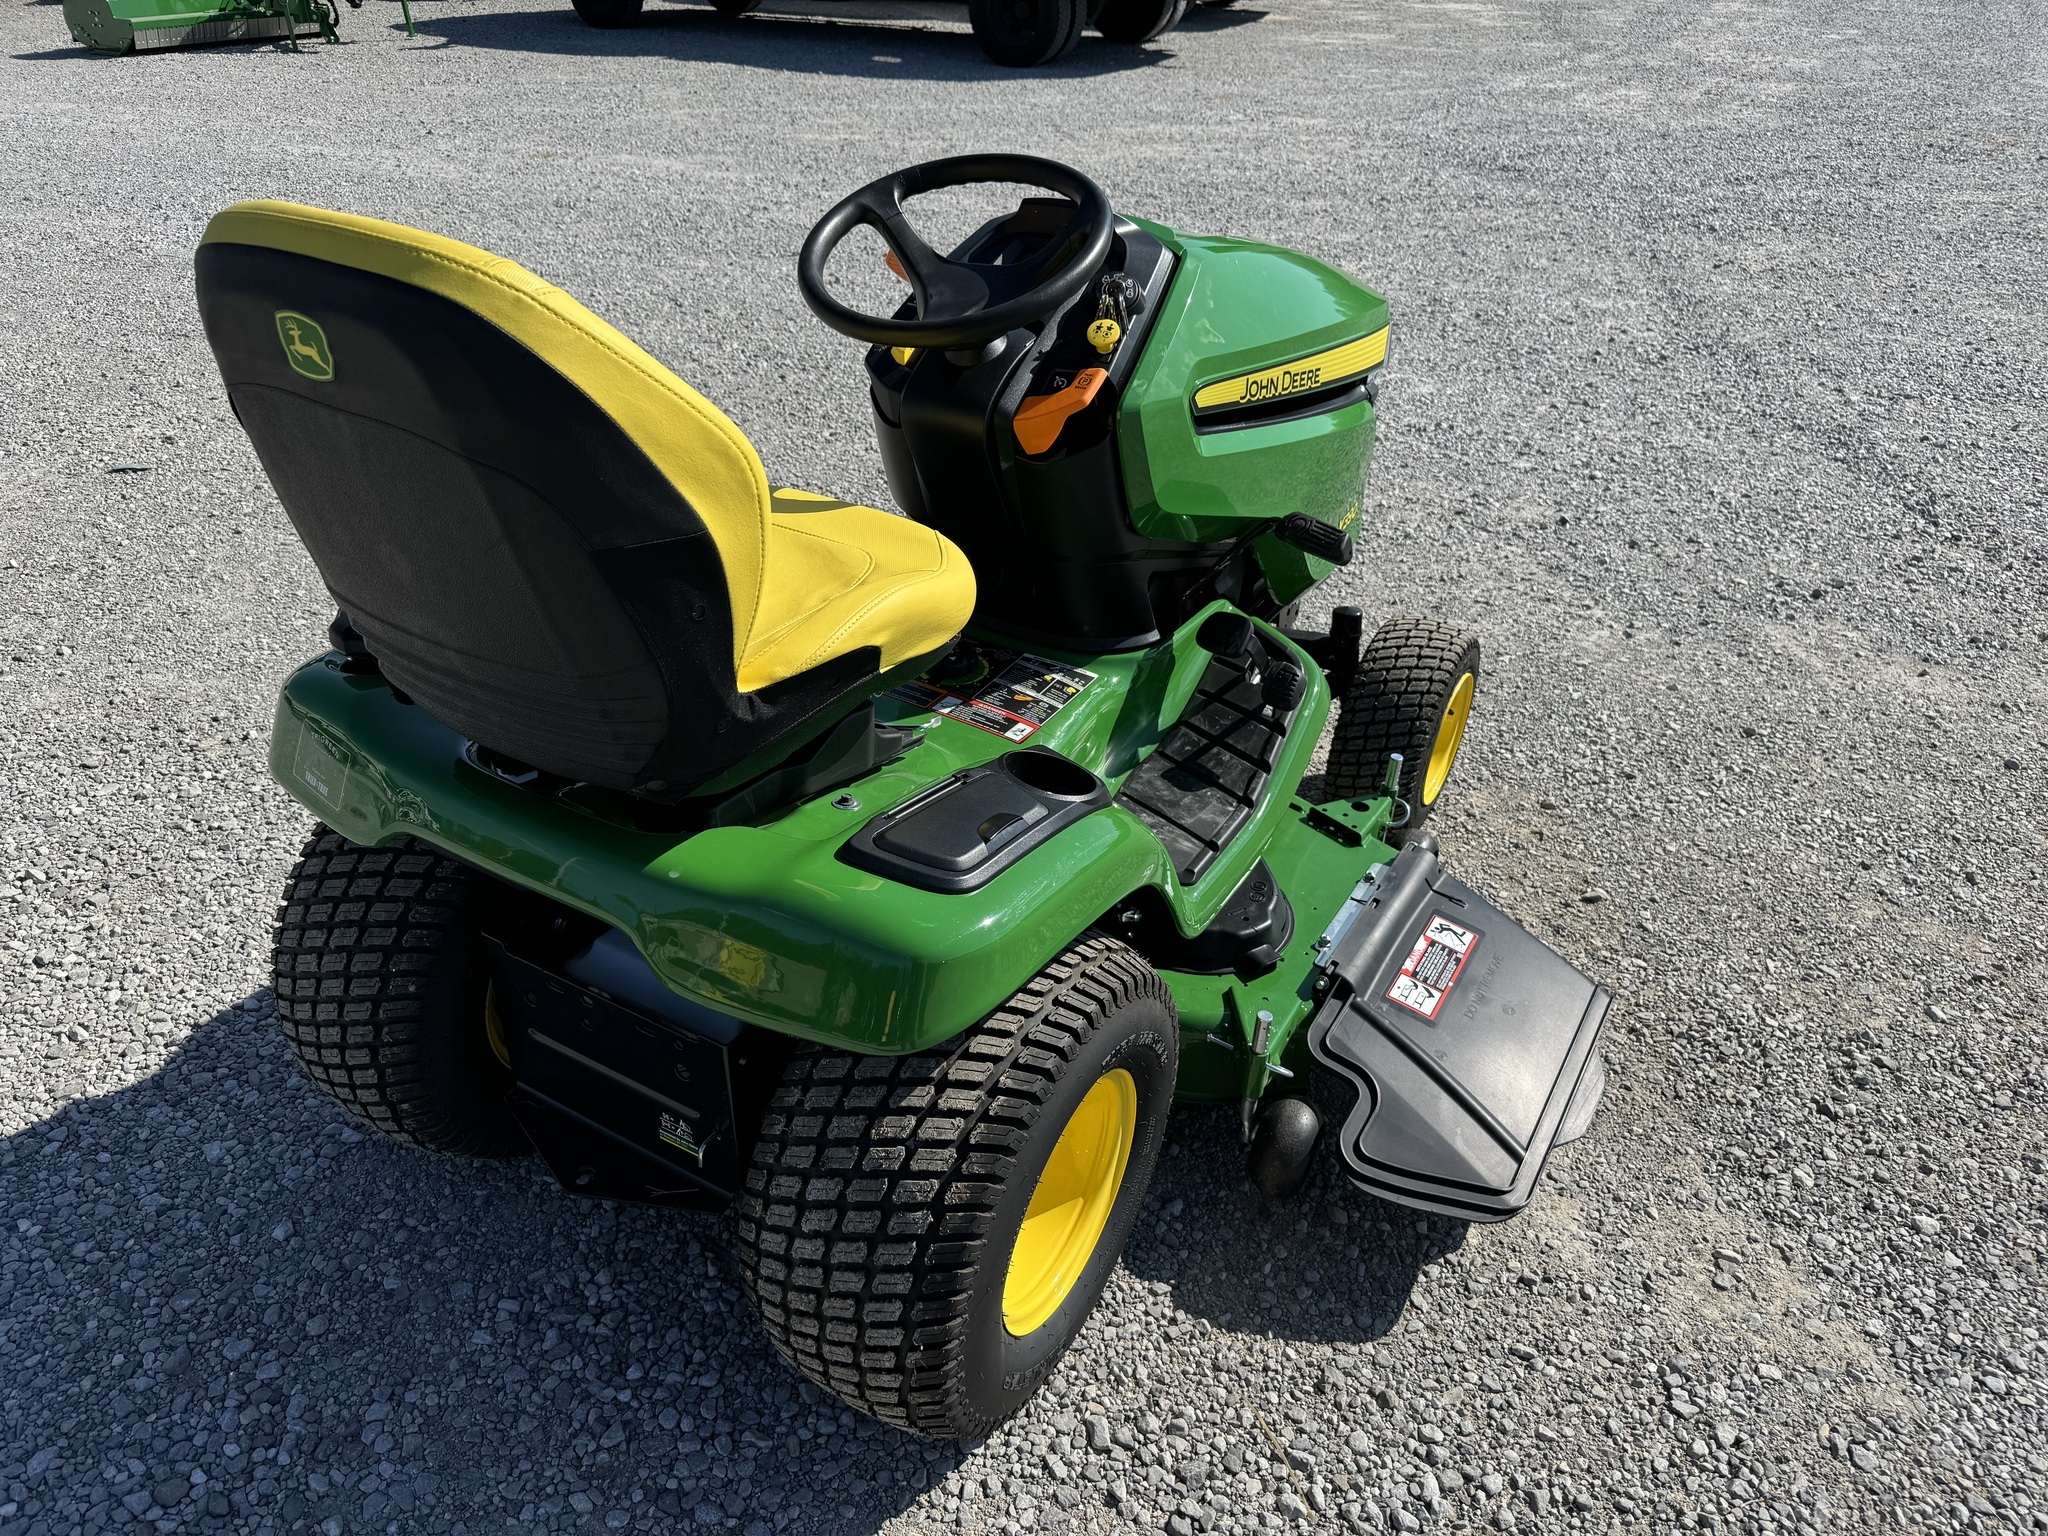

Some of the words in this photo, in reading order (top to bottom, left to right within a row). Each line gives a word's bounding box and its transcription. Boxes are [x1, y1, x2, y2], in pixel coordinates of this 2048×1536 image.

[1239, 377, 1280, 401] JOHN
[1281, 367, 1322, 392] DEERE
[1479, 952, 1505, 989] REMOVE
[1471, 986, 1488, 1006] NOT
[1463, 1004, 1478, 1020] DO
